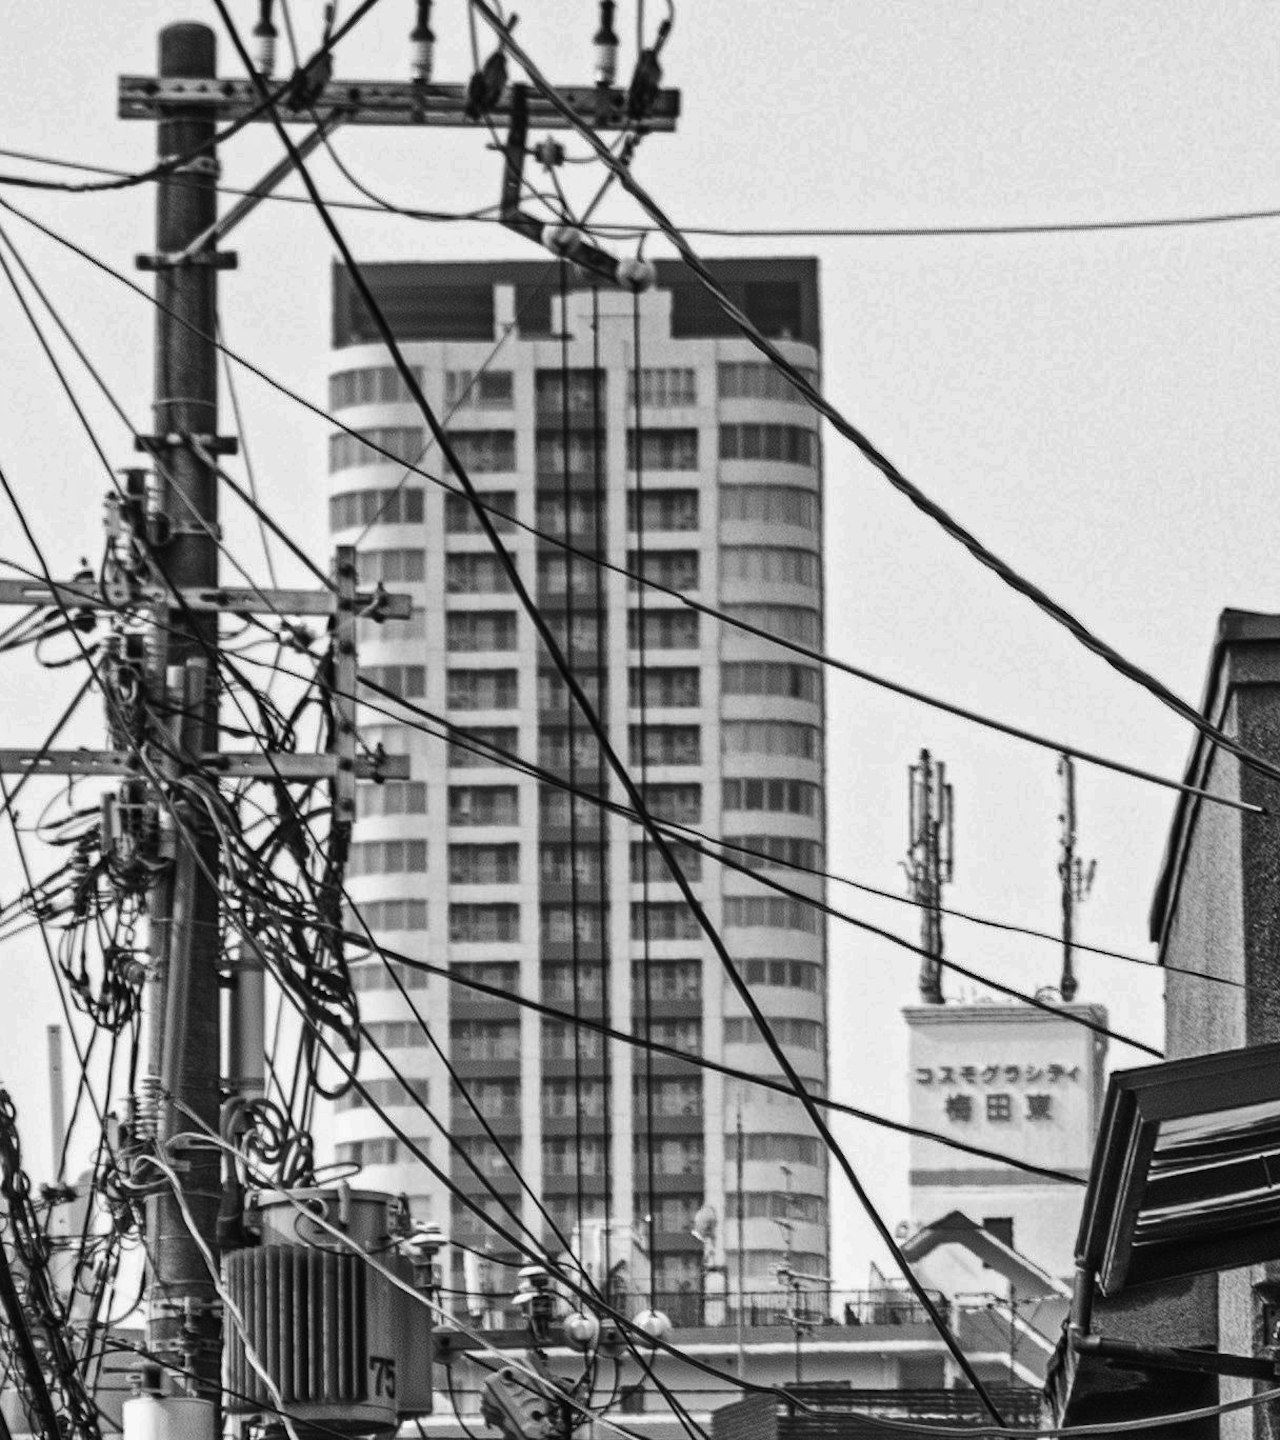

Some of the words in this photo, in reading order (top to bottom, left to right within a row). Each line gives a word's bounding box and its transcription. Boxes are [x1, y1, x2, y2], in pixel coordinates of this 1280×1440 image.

[945, 1092, 1053, 1122] 梅田東
[369, 1356, 396, 1399] 75
